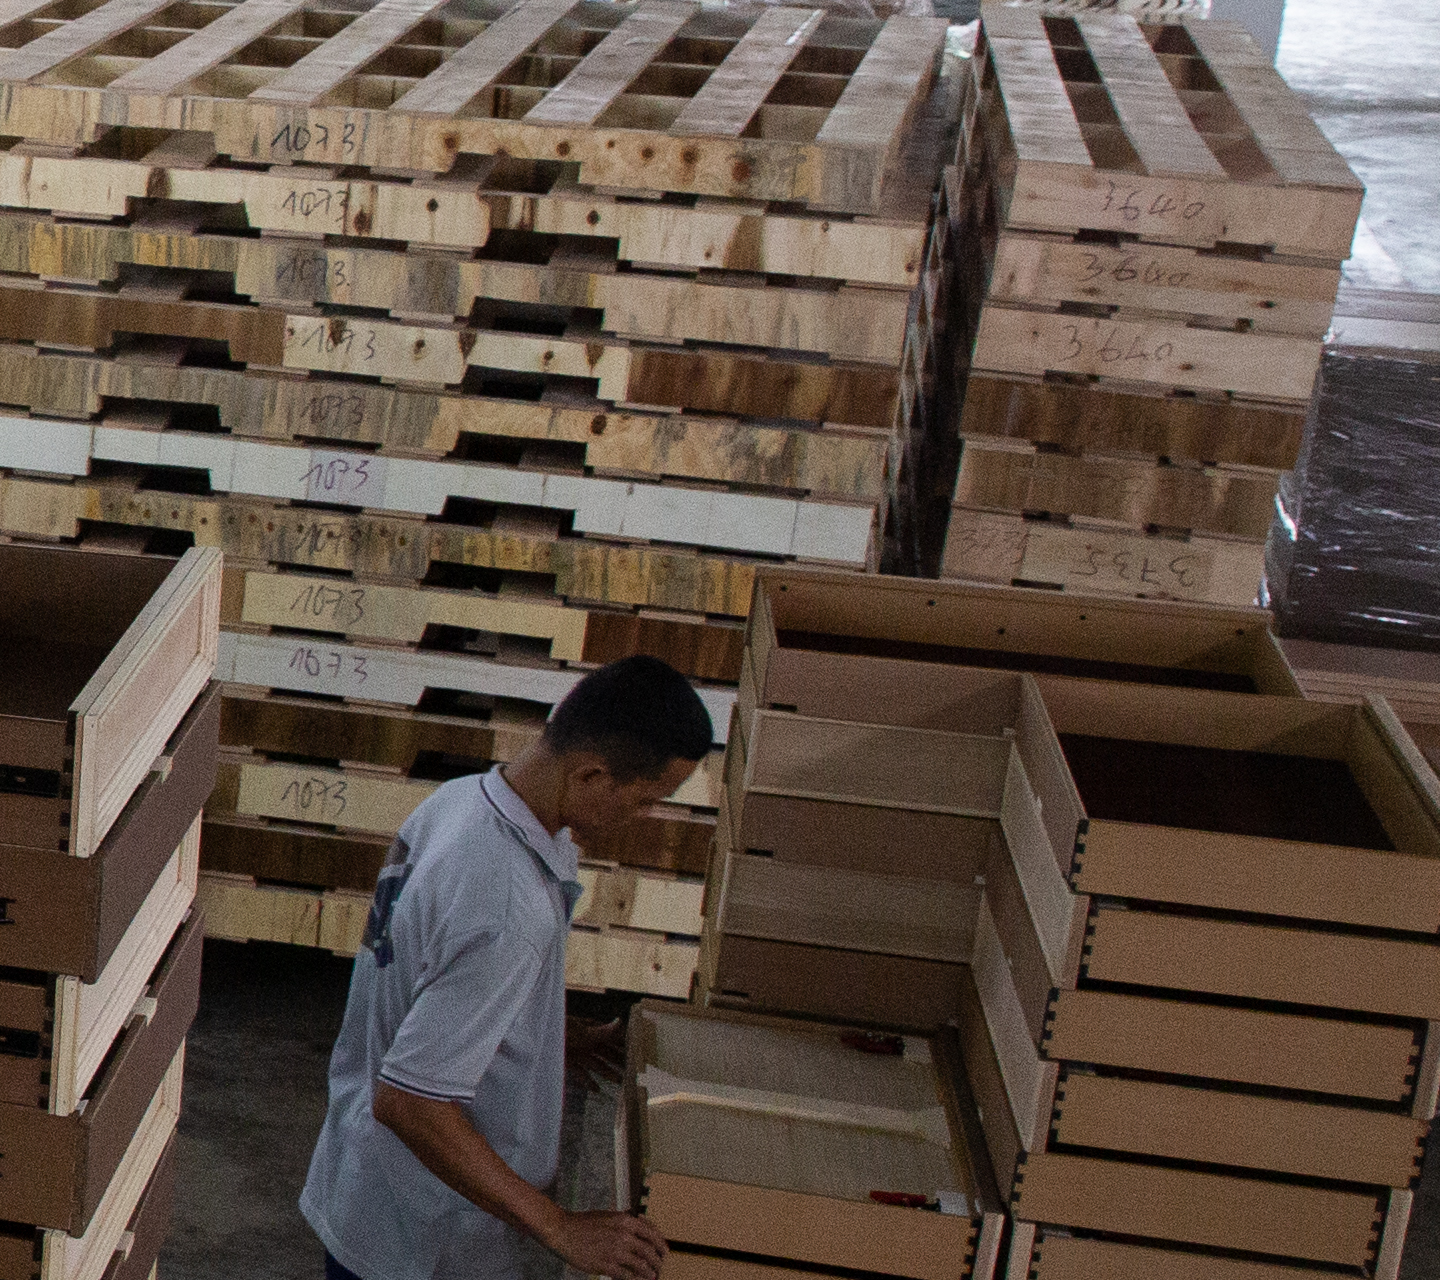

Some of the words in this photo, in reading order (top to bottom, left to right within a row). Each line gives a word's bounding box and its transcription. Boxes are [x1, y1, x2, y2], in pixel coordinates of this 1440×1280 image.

[270, 122, 355, 153] 1073
[281, 187, 349, 222] 1073
[299, 458, 370, 490] 1073
[290, 585, 366, 622] 1073
[289, 646, 368, 684] 1073
[281, 776, 348, 816] 1073
